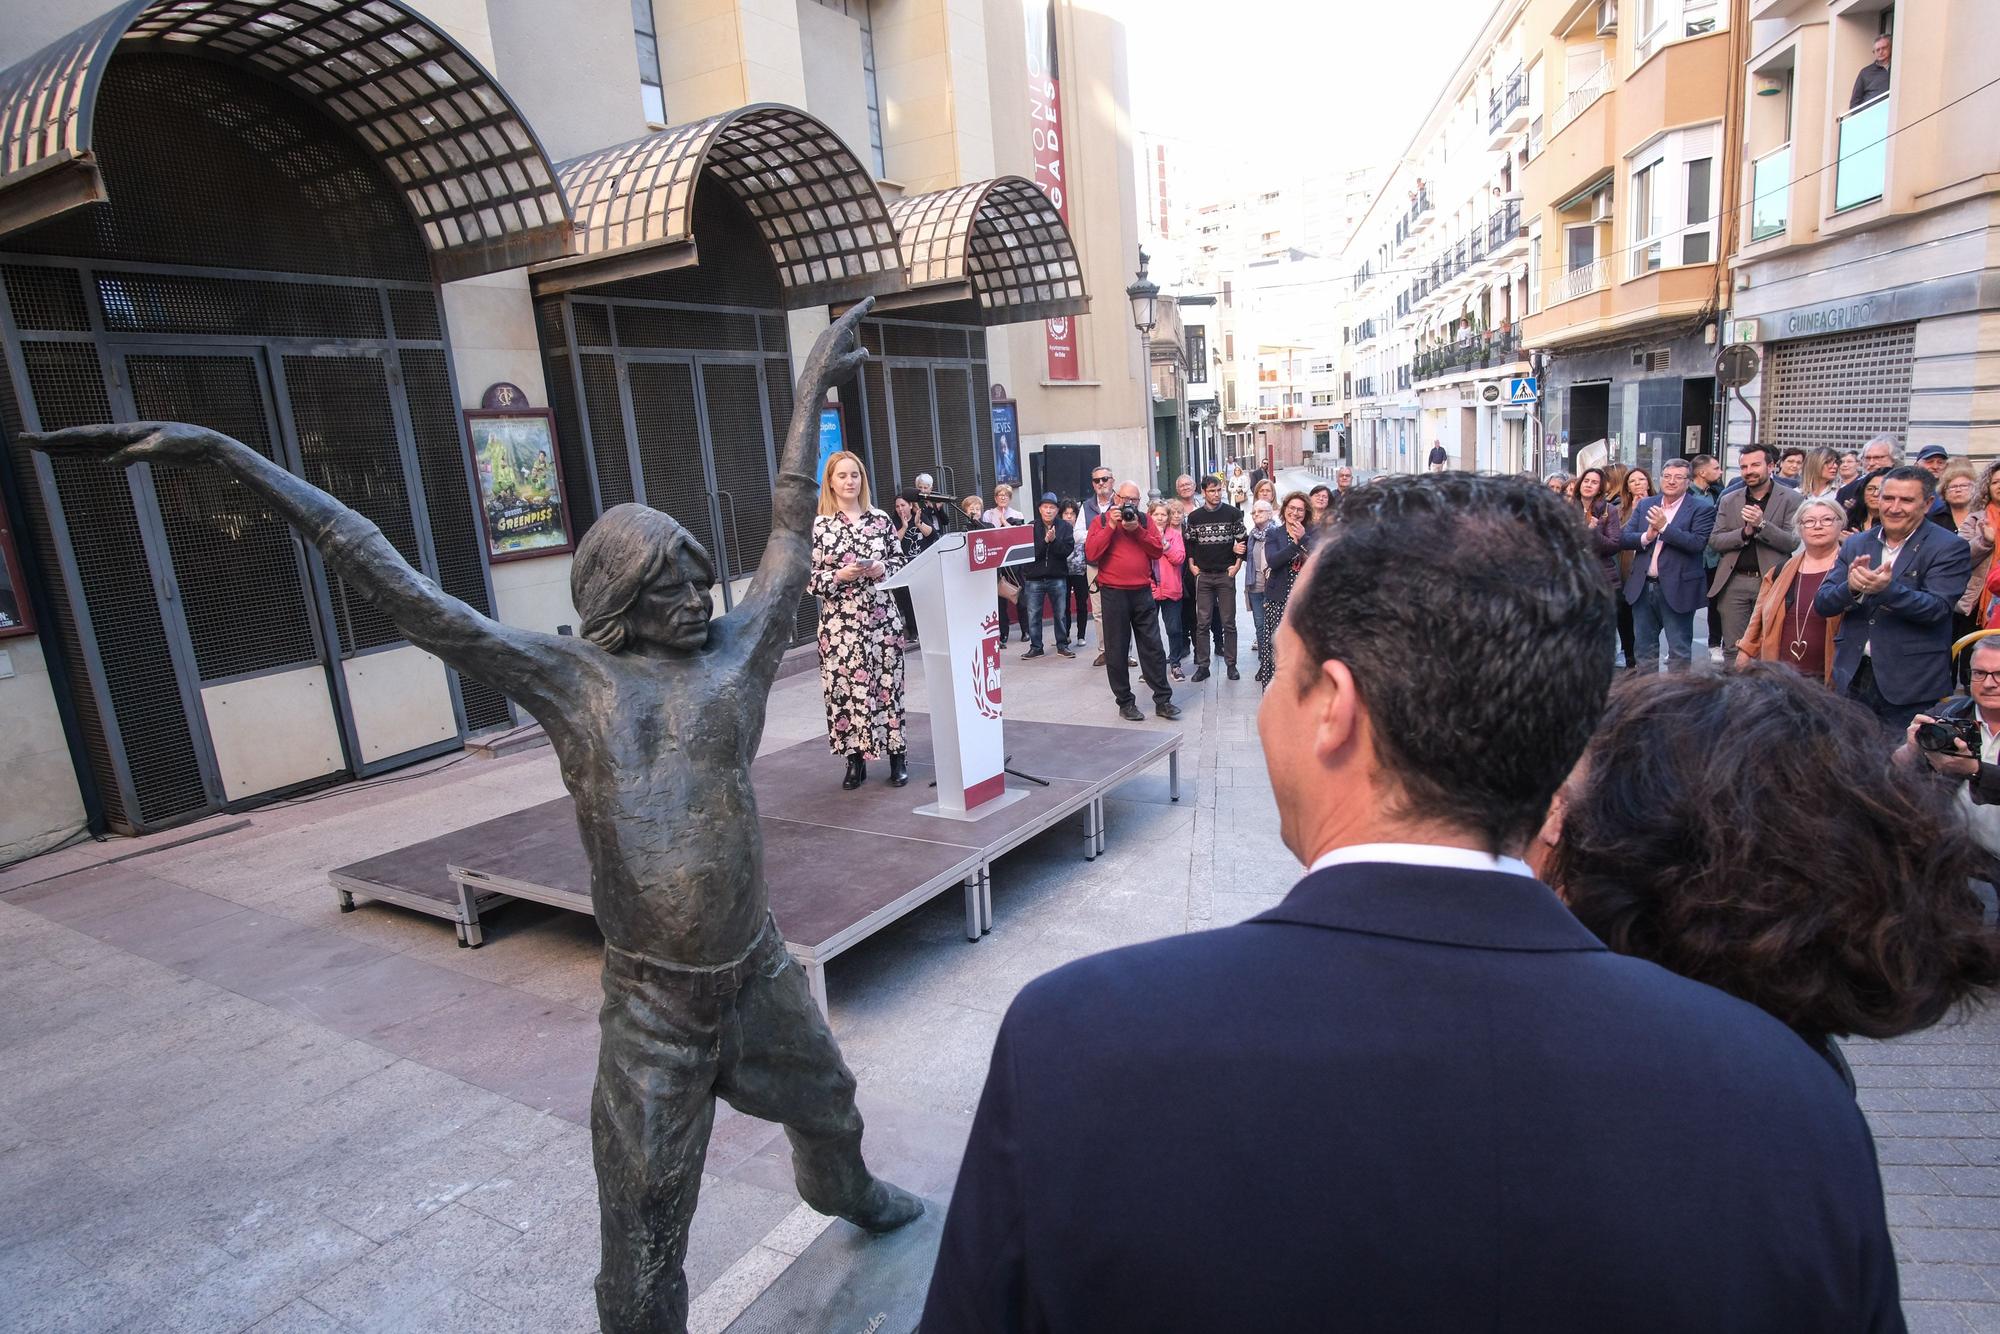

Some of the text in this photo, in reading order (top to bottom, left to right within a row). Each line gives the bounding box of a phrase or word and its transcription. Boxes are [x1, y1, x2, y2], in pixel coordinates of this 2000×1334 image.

[1028, 54, 1048, 192] NTONIO
[1043, 80, 1063, 210] GADES
[1788, 303, 1871, 333] GUINEAGRUPO
[497, 507, 553, 531] GREENPISS
